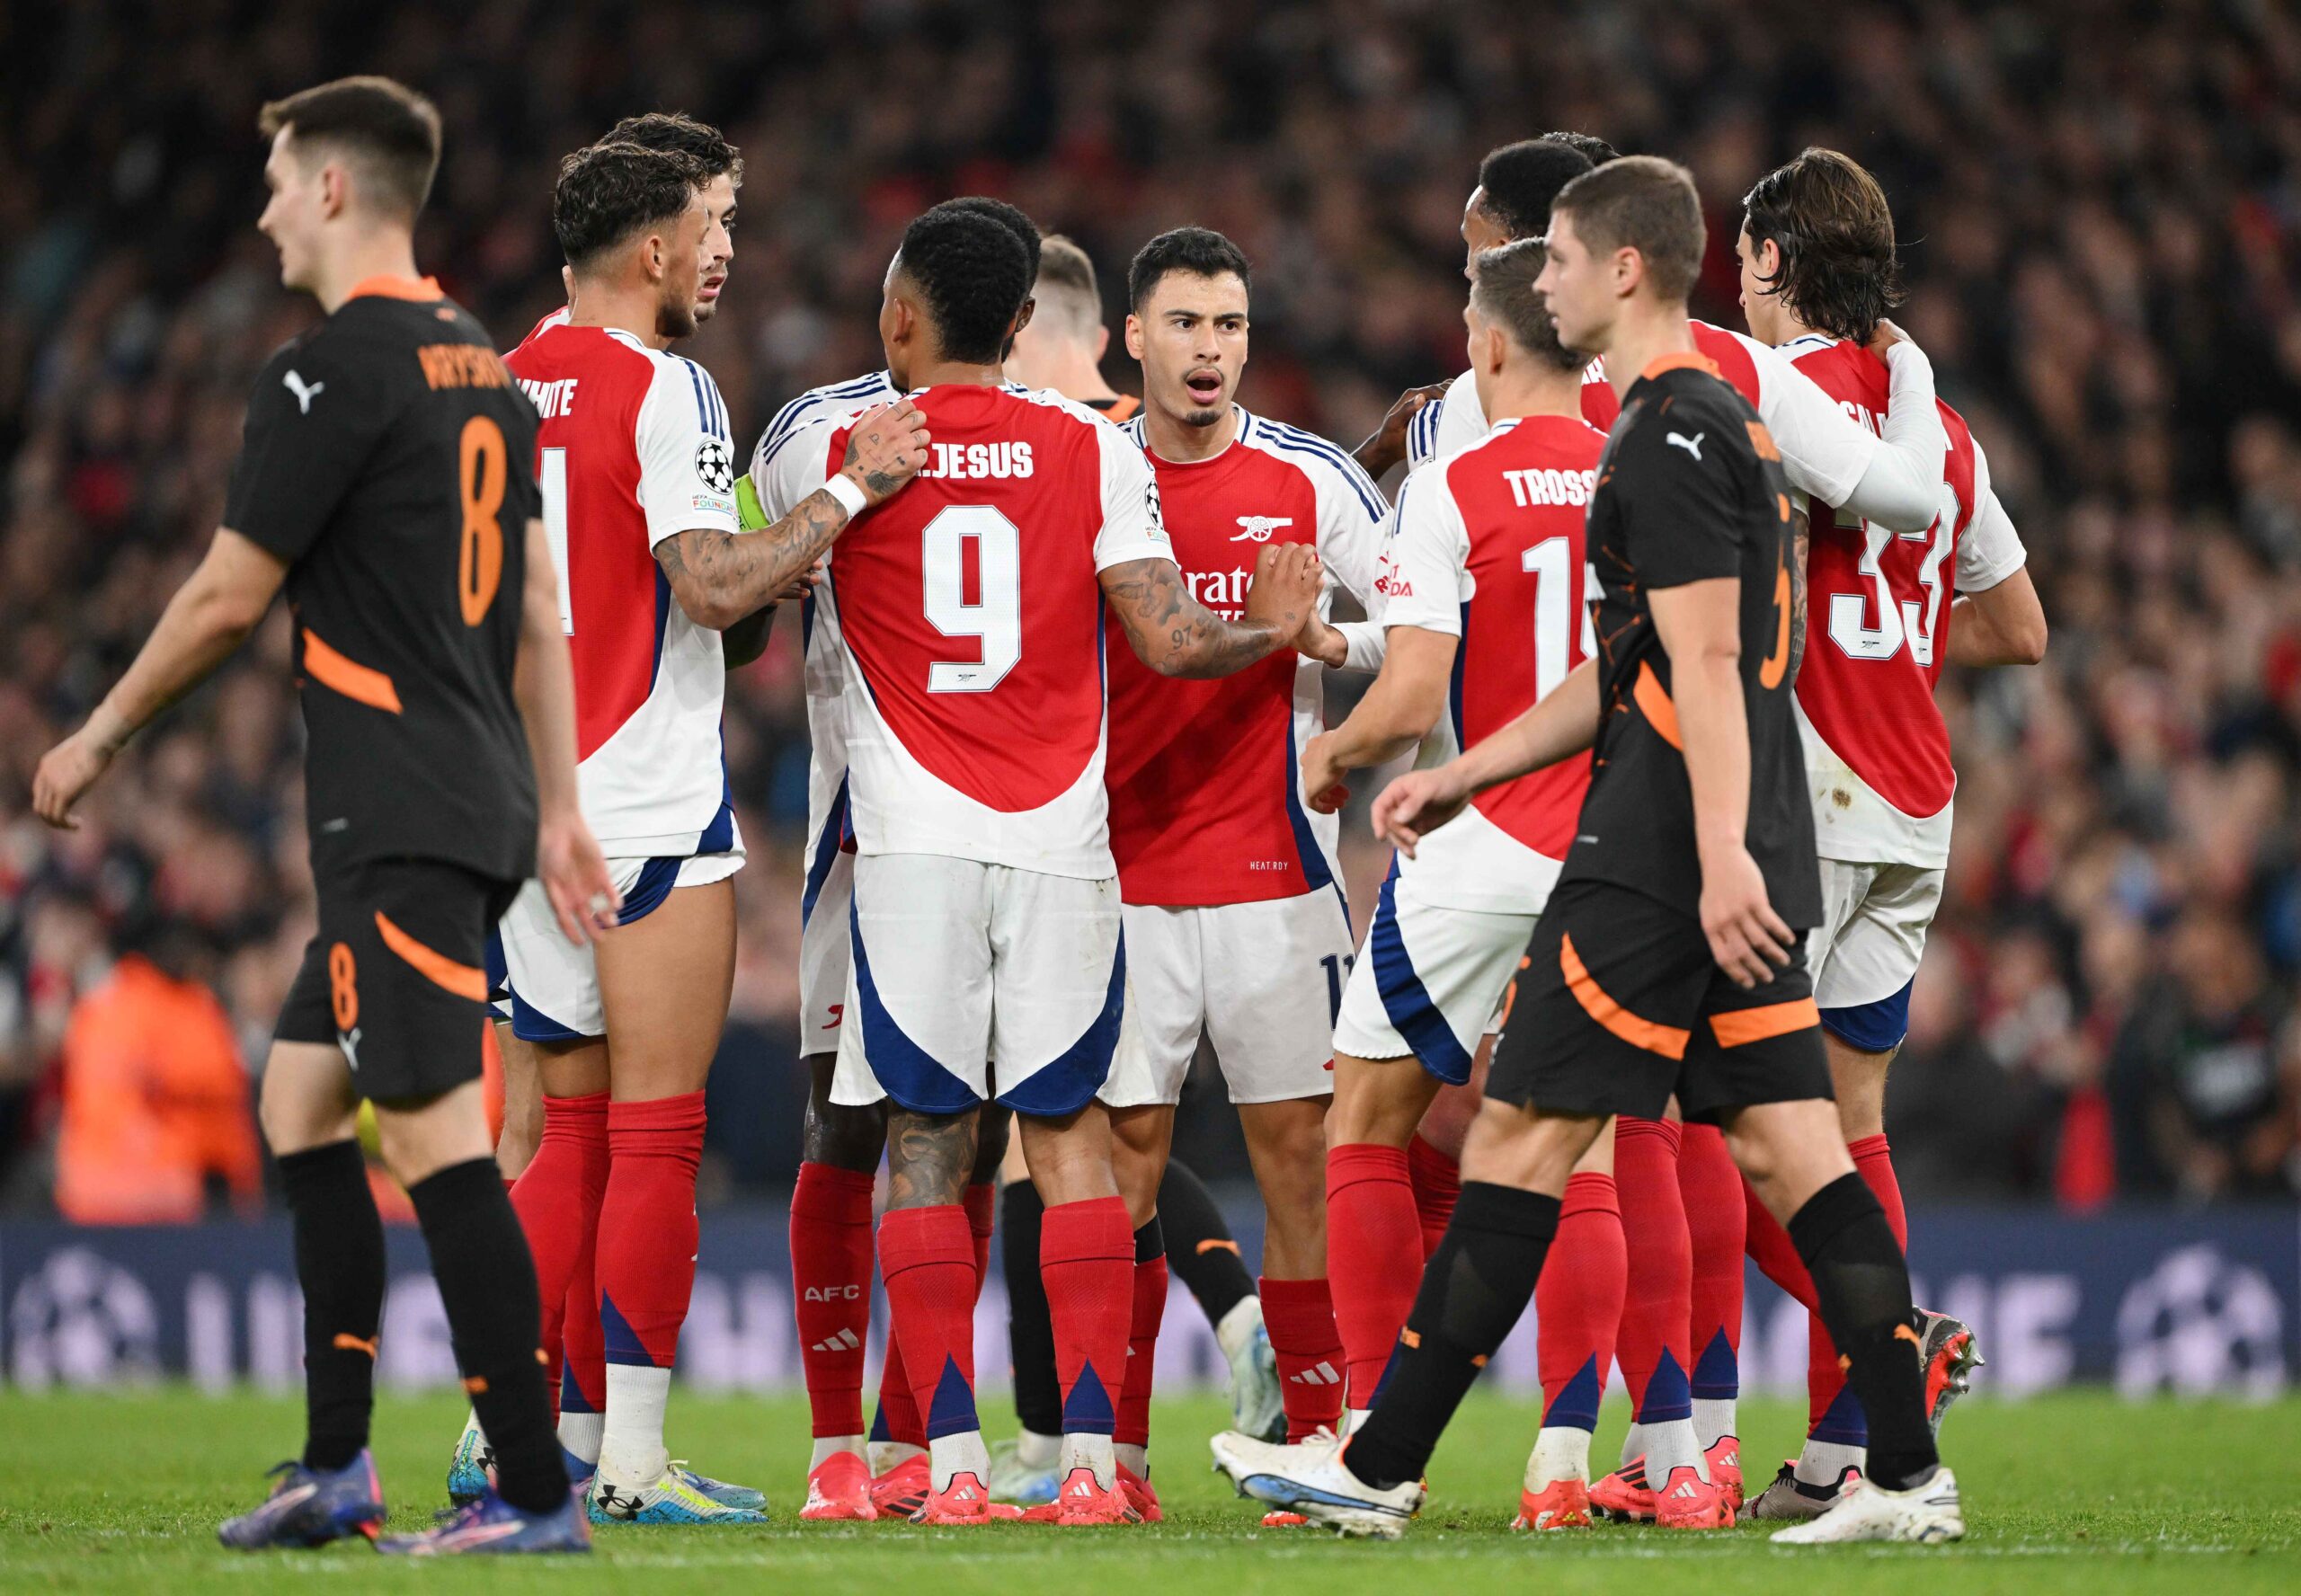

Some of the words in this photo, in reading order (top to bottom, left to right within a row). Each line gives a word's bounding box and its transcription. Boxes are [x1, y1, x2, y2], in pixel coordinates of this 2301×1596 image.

[917, 441, 1034, 479] .JESUS
[1503, 468, 1597, 507] TROSS
[459, 415, 506, 627] 8
[922, 504, 1021, 693] 9
[1249, 861, 1289, 871] HEAT.RDY
[329, 941, 358, 1032] 8
[804, 1284, 859, 1302] AFC
